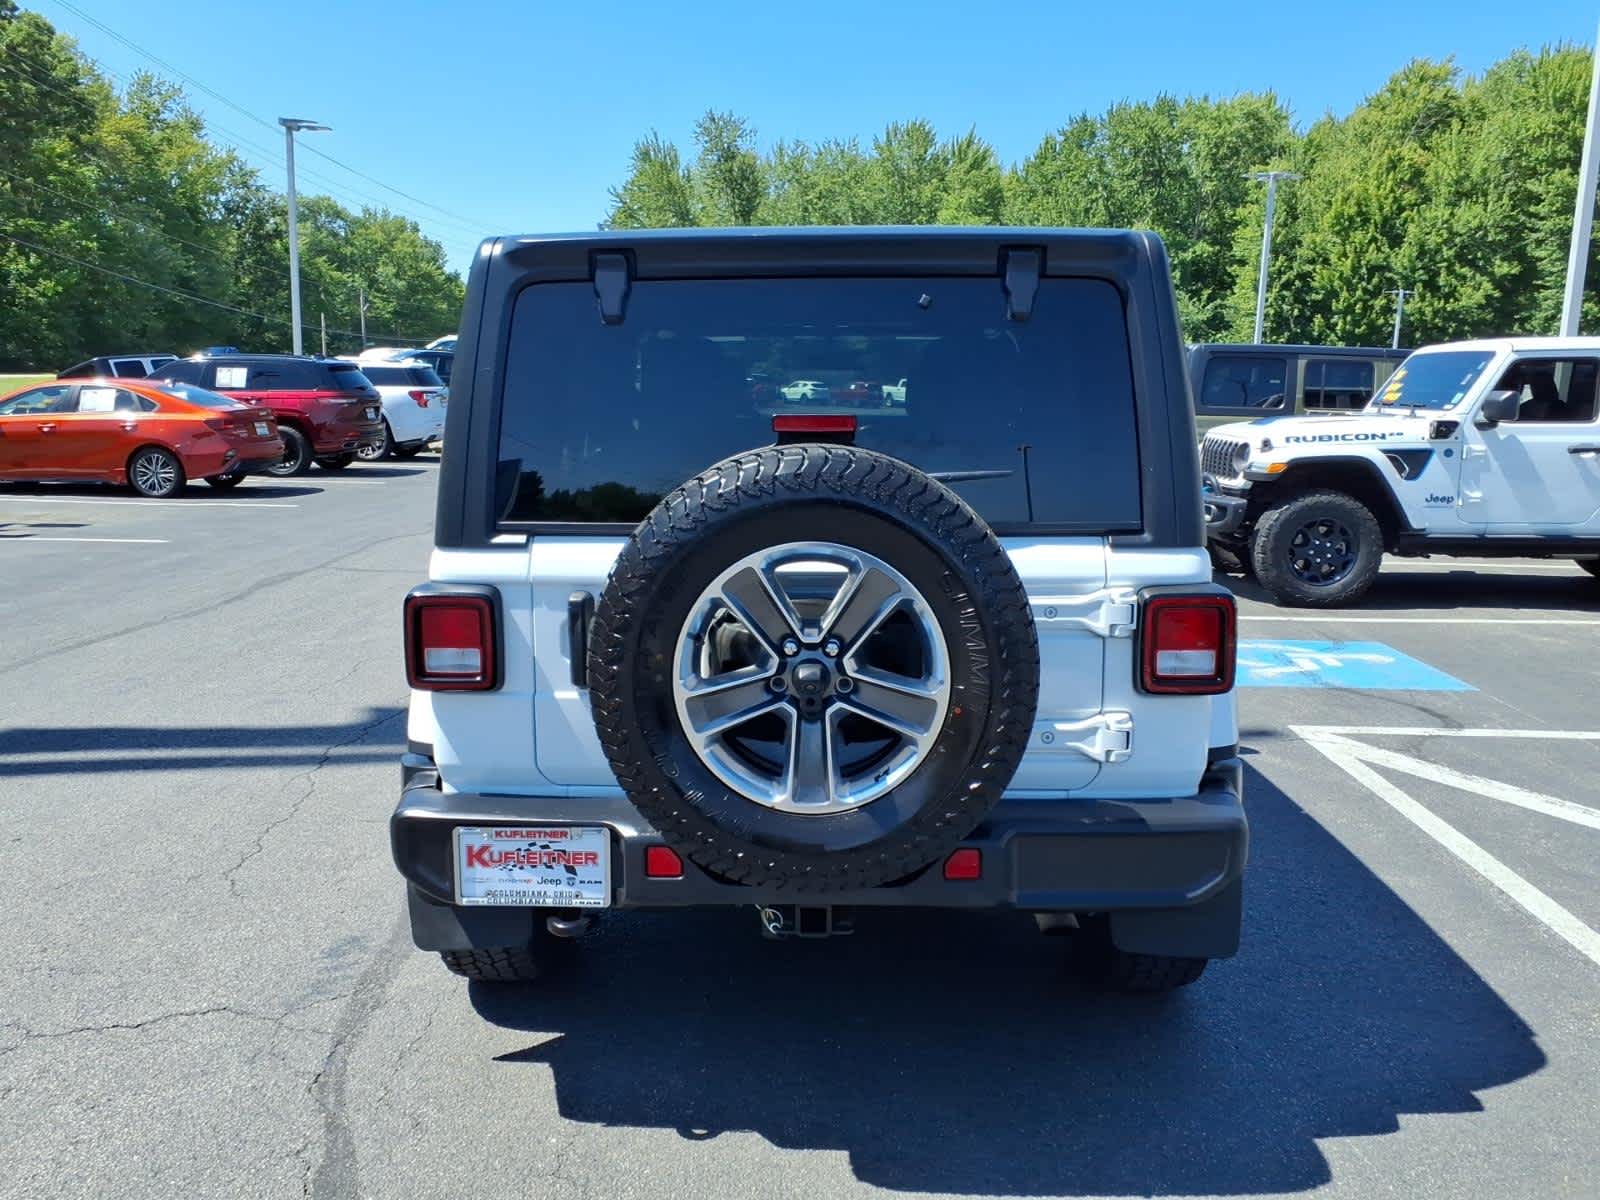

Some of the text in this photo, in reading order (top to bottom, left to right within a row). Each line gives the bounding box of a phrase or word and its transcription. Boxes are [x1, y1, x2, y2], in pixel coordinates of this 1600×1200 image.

[1285, 433, 1386, 443] RUBICON
[1424, 493, 1455, 504] Jeep
[494, 829, 569, 839] KUFLEITNER
[466, 843, 598, 868] KUFLEITNER
[536, 876, 562, 886] Jeep
[554, 890, 573, 898] OHIO
